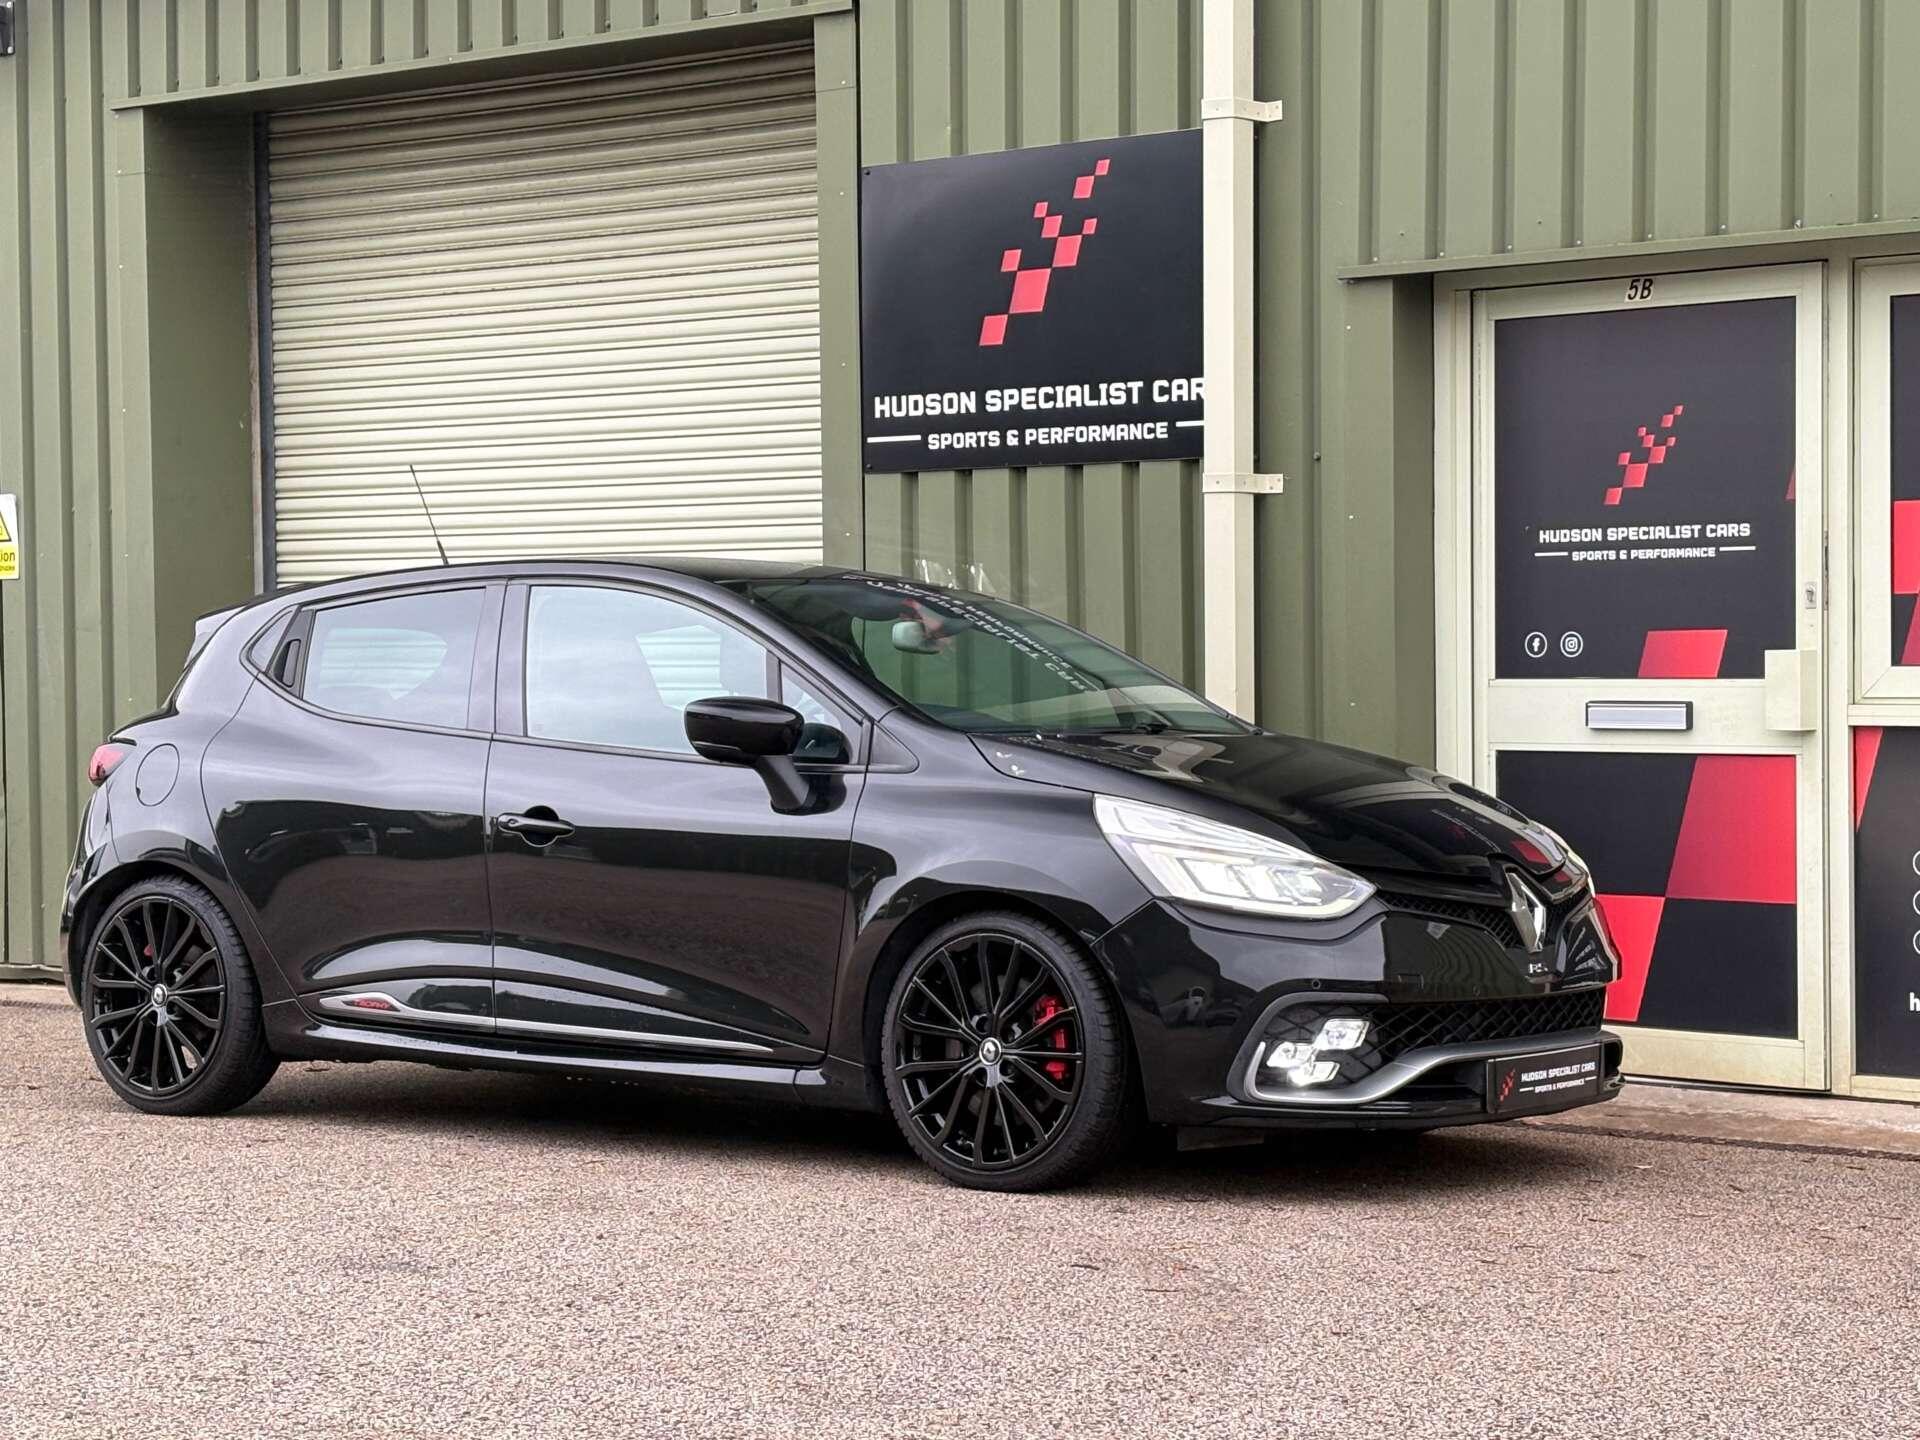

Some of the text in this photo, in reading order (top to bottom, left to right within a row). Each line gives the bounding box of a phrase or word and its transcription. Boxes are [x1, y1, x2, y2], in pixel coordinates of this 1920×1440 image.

[1628, 278, 1653, 300] 5B
[875, 377, 1204, 418] HUDSON SPECIALIST CAR
[928, 422, 1168, 450] SPORTS & PERFORMANCE
[1539, 523, 1751, 544] HUDSON SPECIALIST CARS
[1572, 550, 1616, 562] SPORTS
[1630, 547, 1716, 560] PERFORMANCE
[1521, 1061, 1596, 1082] HUDSON SPECIALIST CARS
